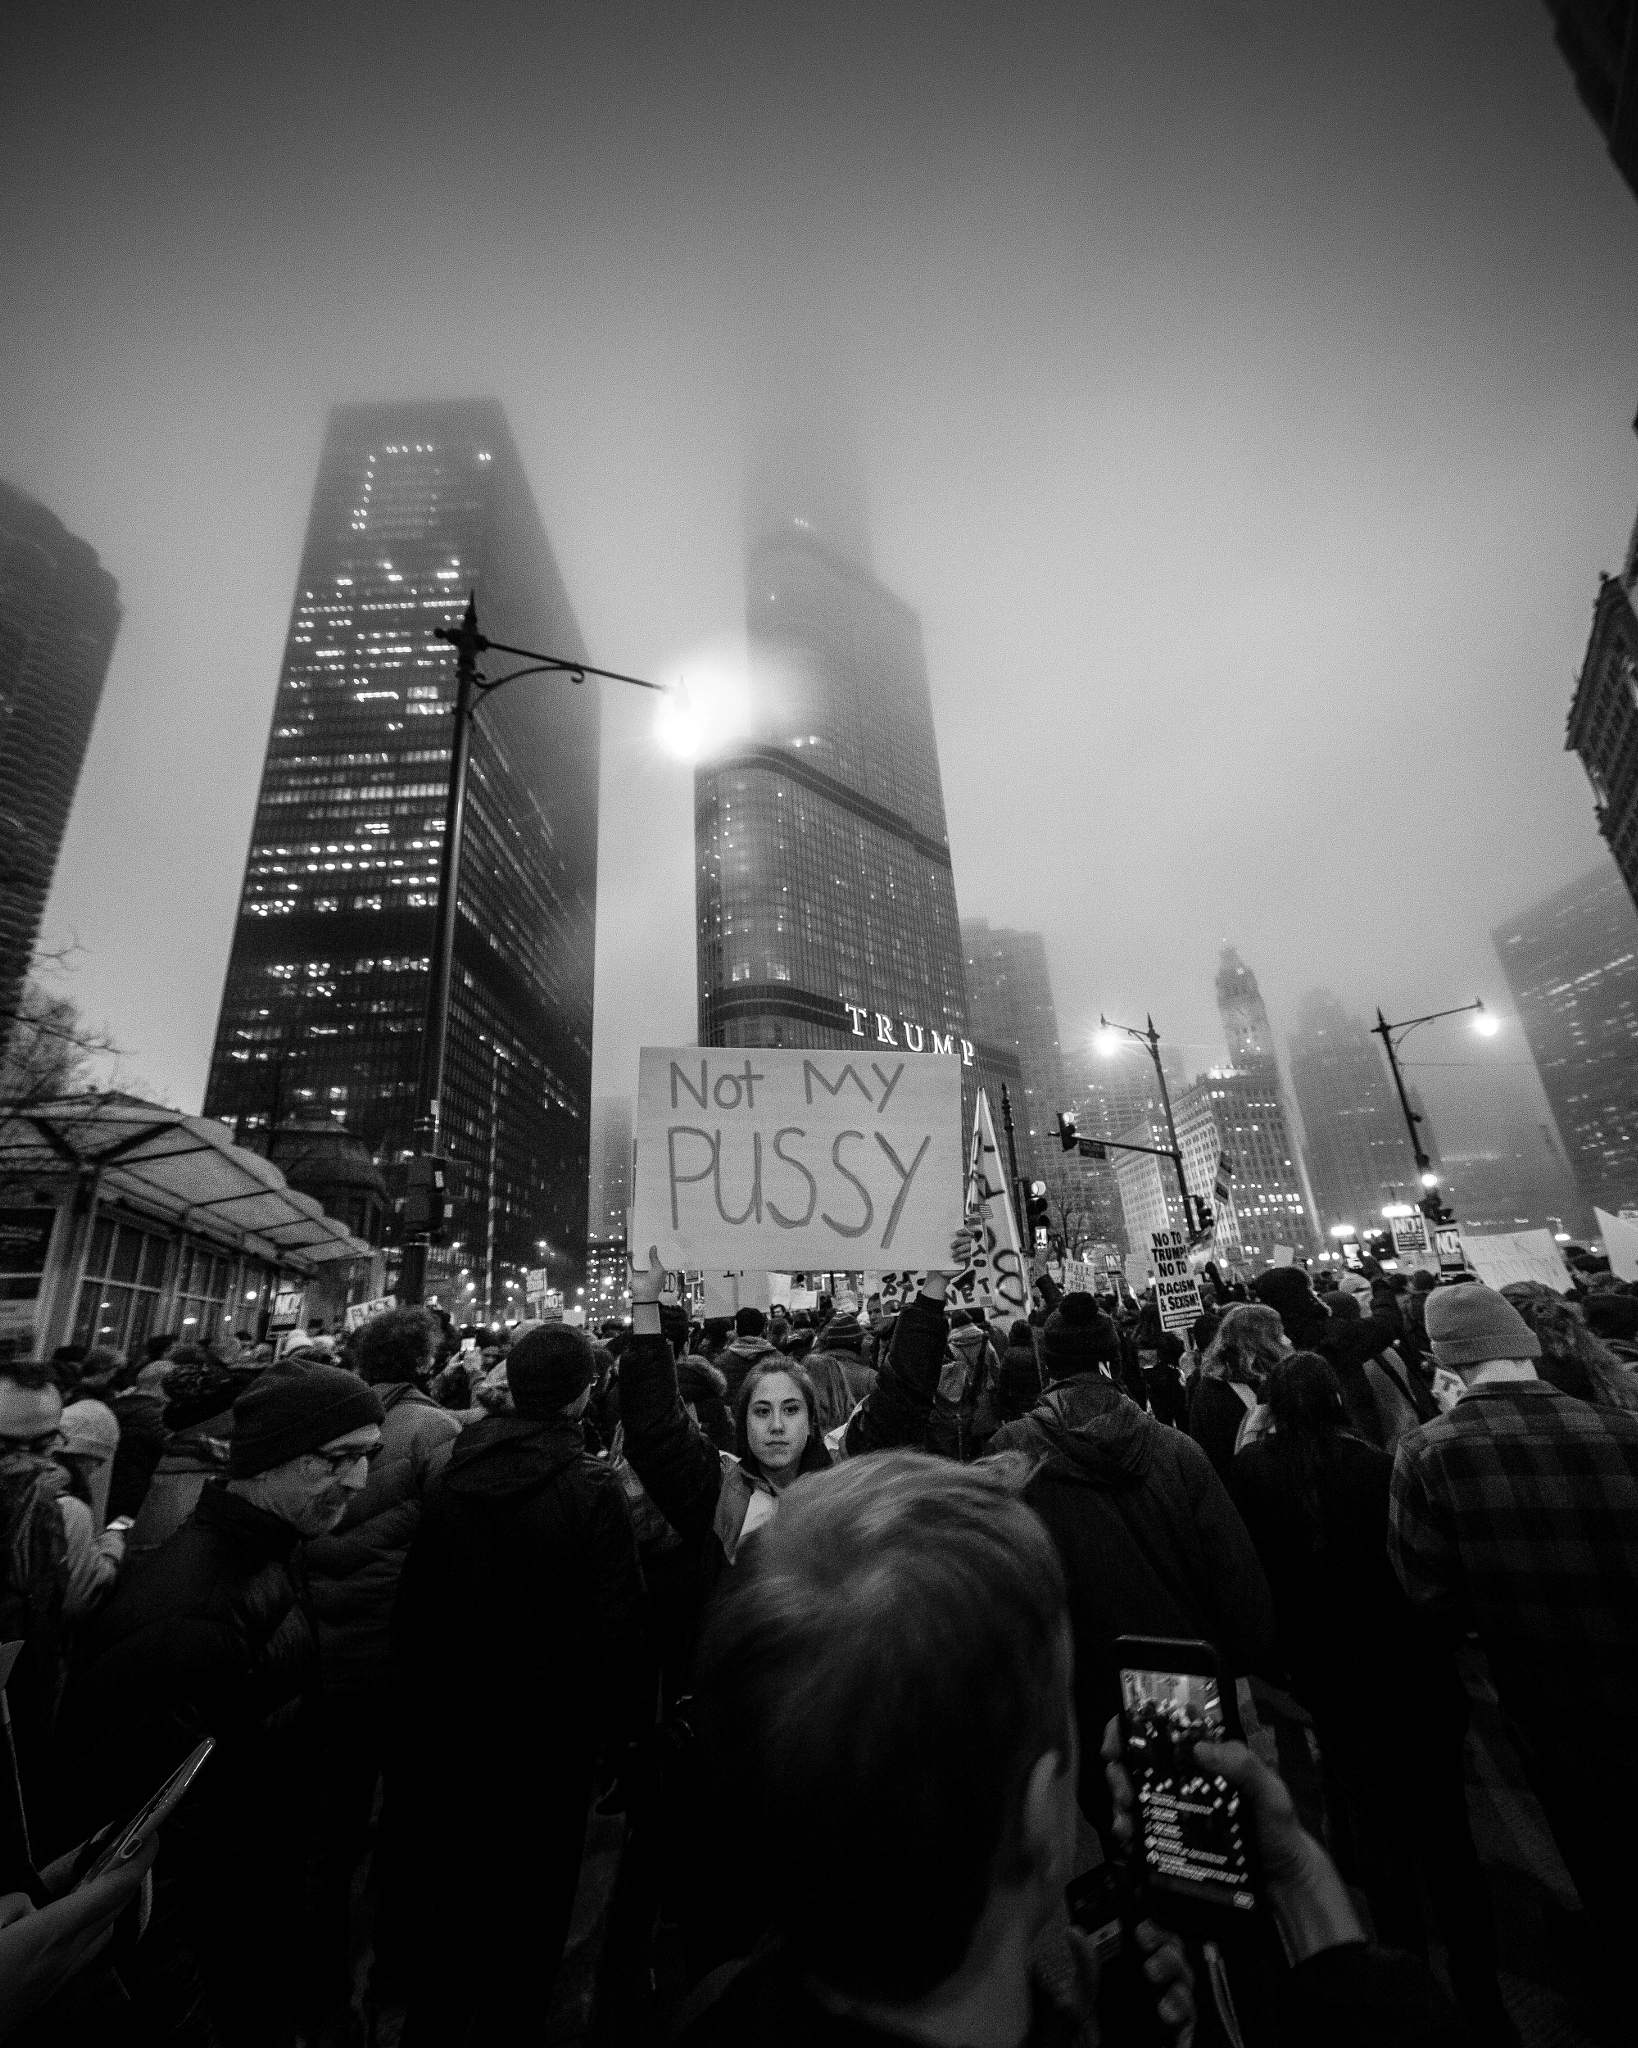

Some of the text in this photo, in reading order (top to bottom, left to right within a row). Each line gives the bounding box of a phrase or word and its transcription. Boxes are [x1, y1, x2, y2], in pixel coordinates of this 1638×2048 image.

[844, 1003, 975, 1067] TRUMP
[670, 1059, 904, 1113] Not MY
[668, 1125, 931, 1249] PUSSY
[1394, 1217, 1423, 1234] NO!
[1151, 1231, 1182, 1247] NO TO
[1158, 1261, 1187, 1277] NO TO
[1158, 1279, 1196, 1296] RACISM
[1168, 1292, 1200, 1310] SEXISM!
